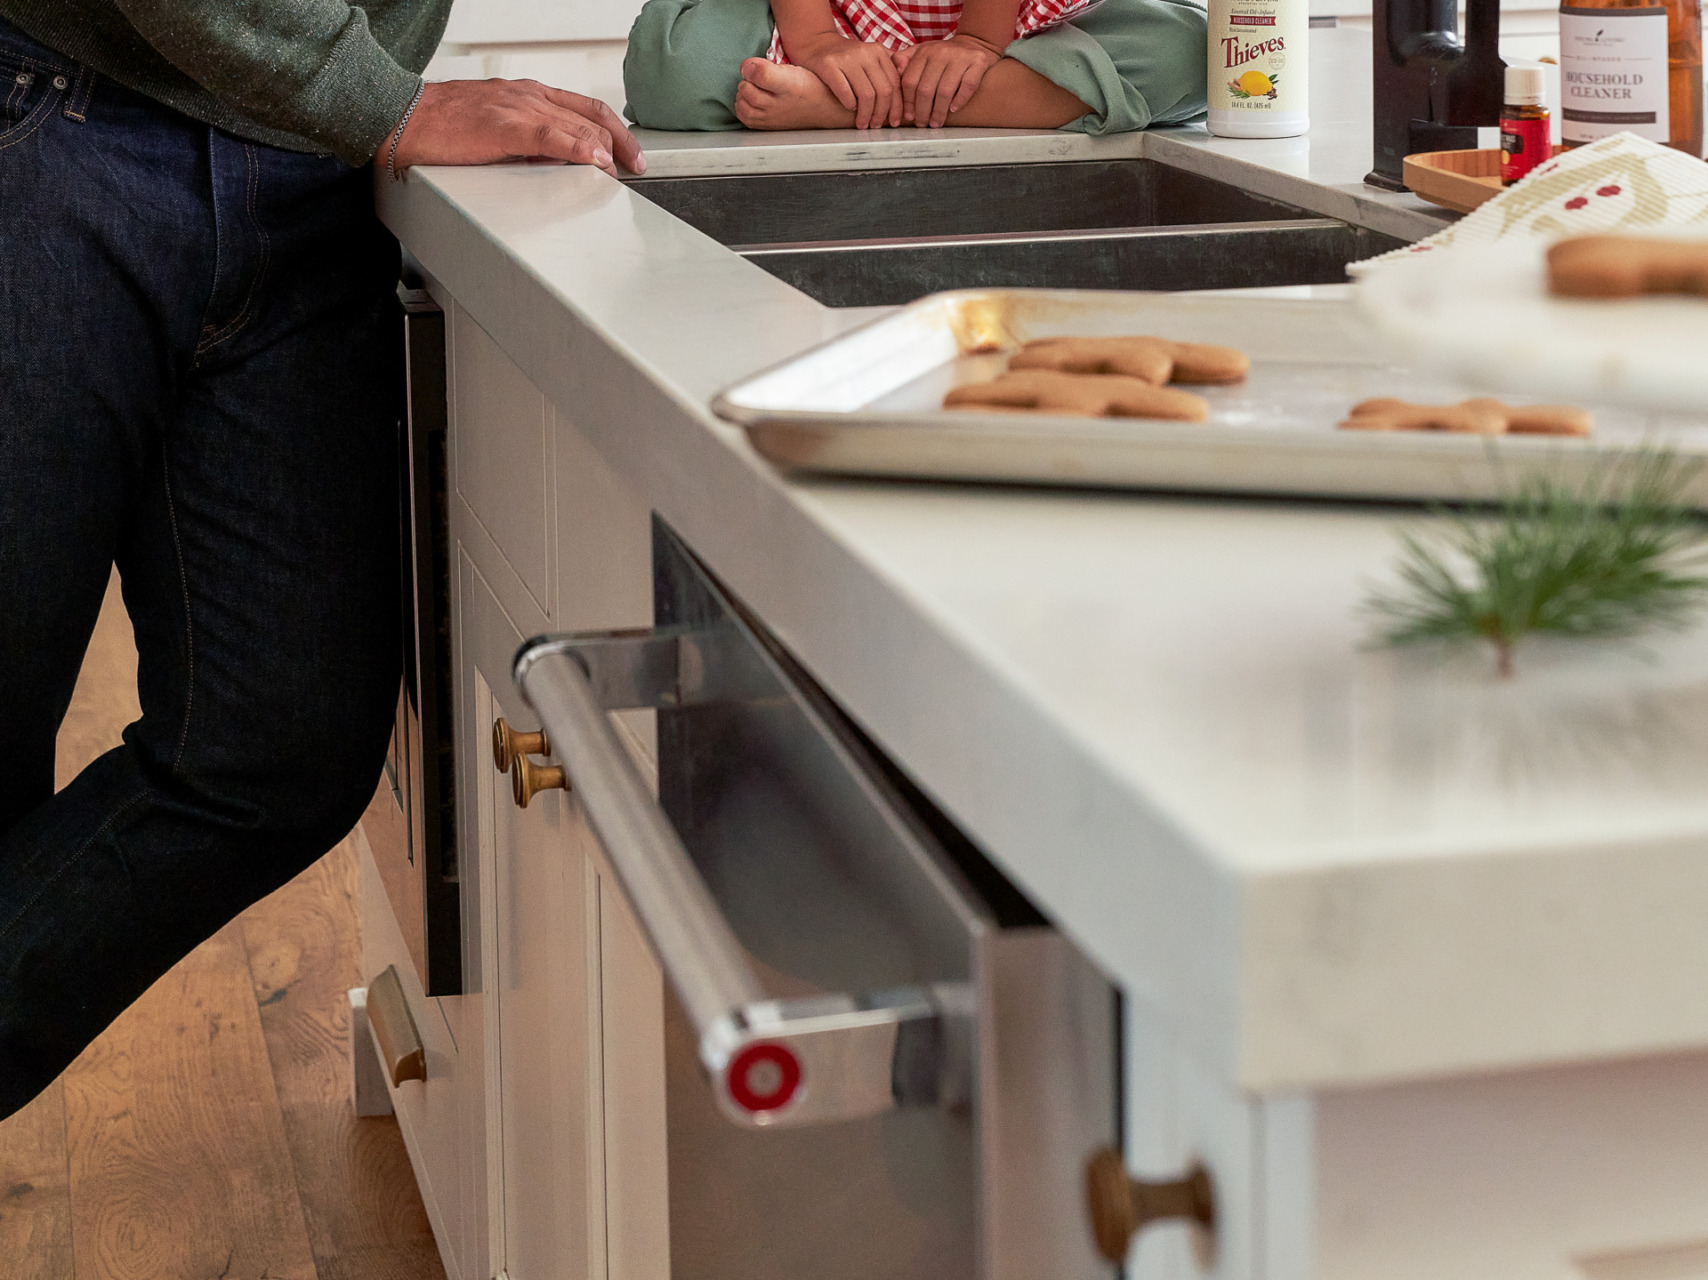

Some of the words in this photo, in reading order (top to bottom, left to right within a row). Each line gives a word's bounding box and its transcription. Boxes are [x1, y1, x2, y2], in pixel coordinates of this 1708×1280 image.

[1221, 36, 1284, 68] Thieves
[1566, 72, 1643, 85] HOUSEHOLD
[1571, 87, 1631, 99] CLEANER
